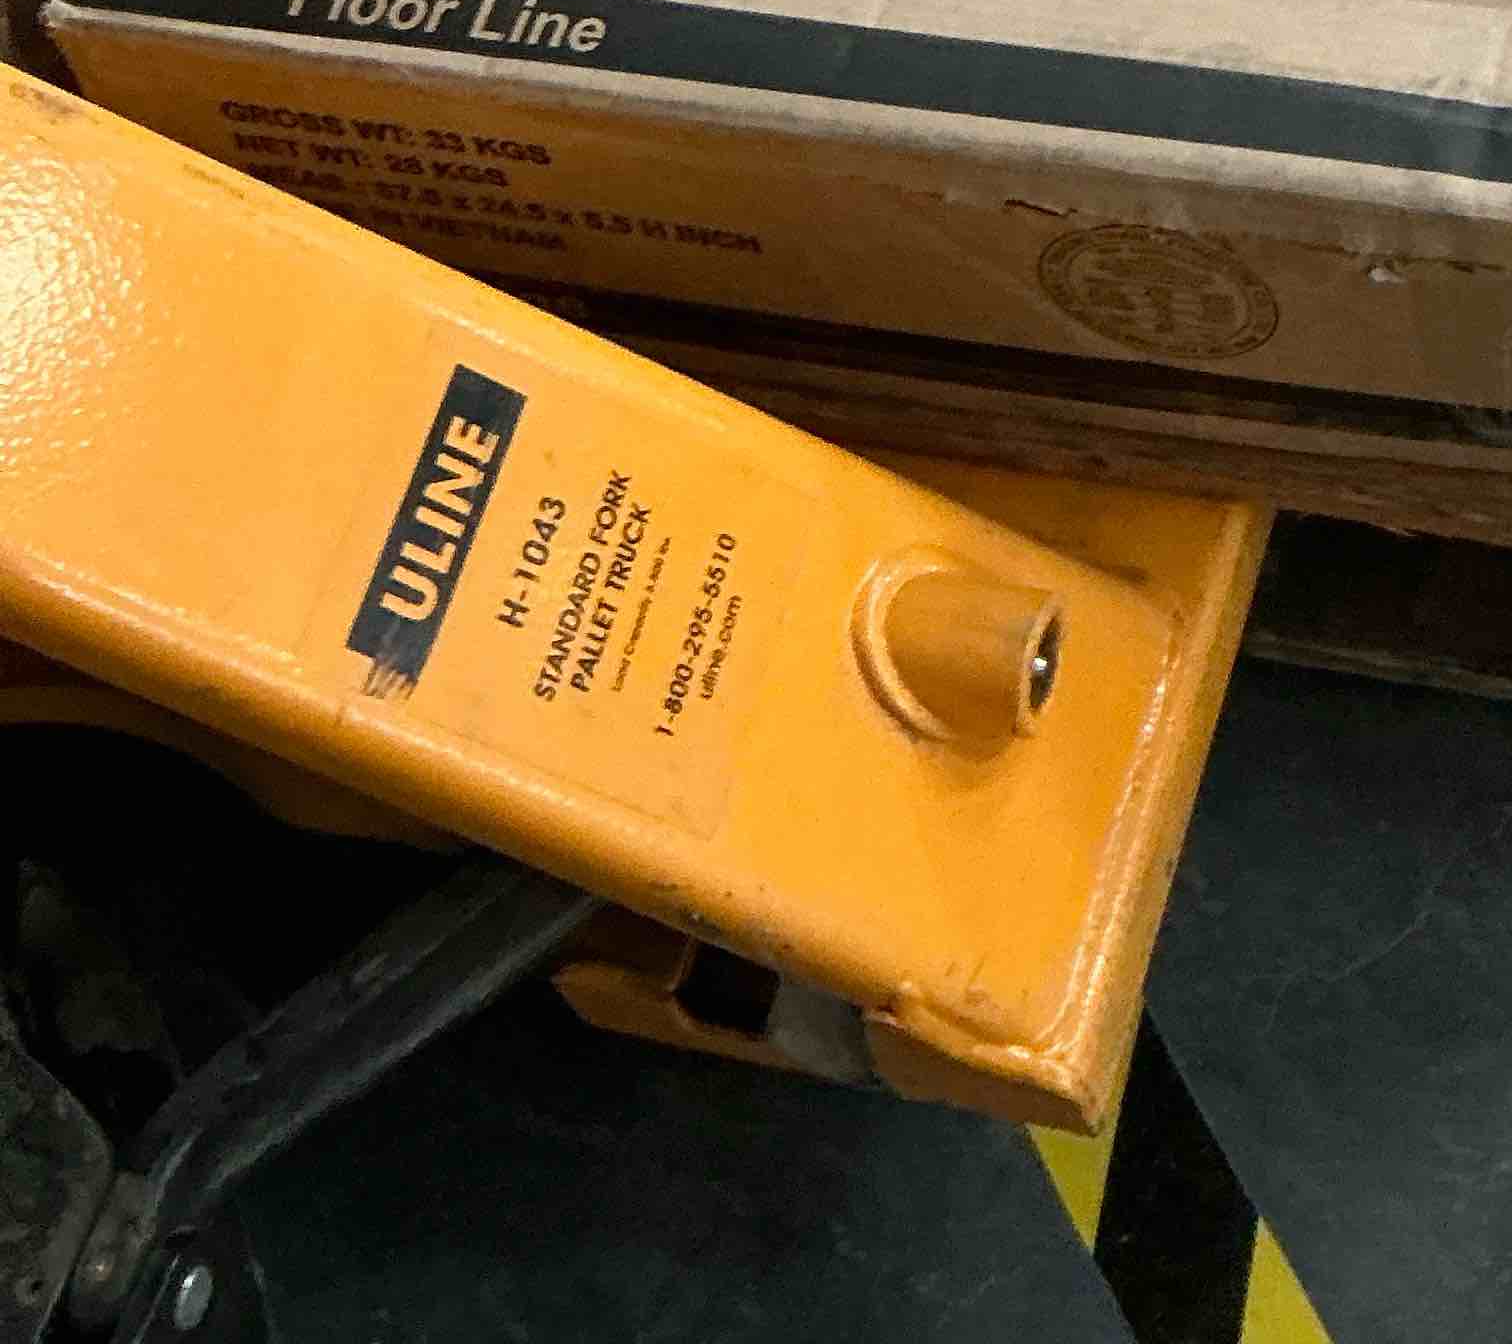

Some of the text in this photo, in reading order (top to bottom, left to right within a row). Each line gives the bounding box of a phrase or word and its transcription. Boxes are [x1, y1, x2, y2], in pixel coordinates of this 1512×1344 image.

[219, 100, 346, 136] GROSS
[470, 134, 551, 165] KGS
[430, 160, 510, 188] KGS
[380, 415, 500, 621] ULINE
[495, 496, 567, 629] H-1043
[534, 468, 632, 702] STANDARD FORK
[569, 595, 618, 693] PALLET
[603, 502, 652, 592] TRUCK
